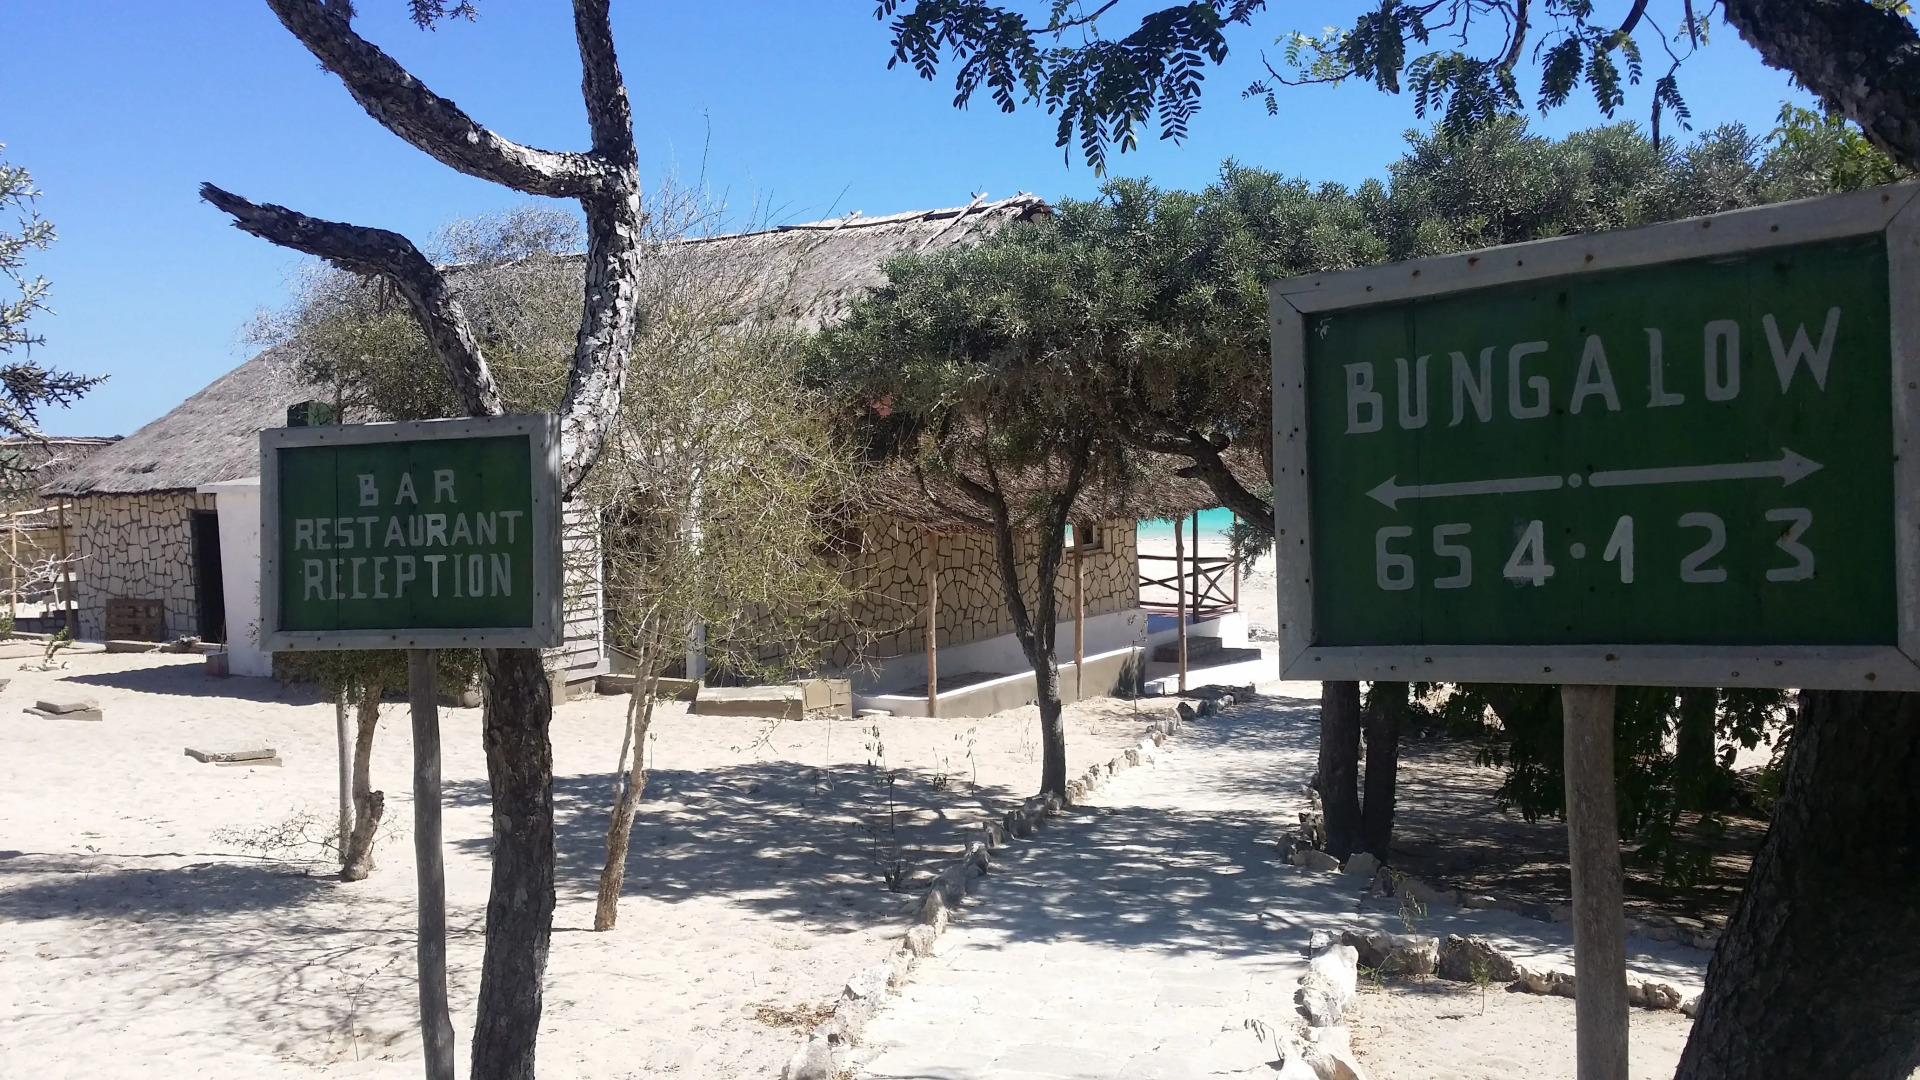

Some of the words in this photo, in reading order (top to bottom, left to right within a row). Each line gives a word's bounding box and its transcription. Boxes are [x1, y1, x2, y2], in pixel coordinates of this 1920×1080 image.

[1343, 307, 1841, 434] BUNGALOW
[357, 469, 457, 506] BAR
[294, 511, 523, 550] RESTAURANT
[302, 553, 512, 600] RECEPTION
